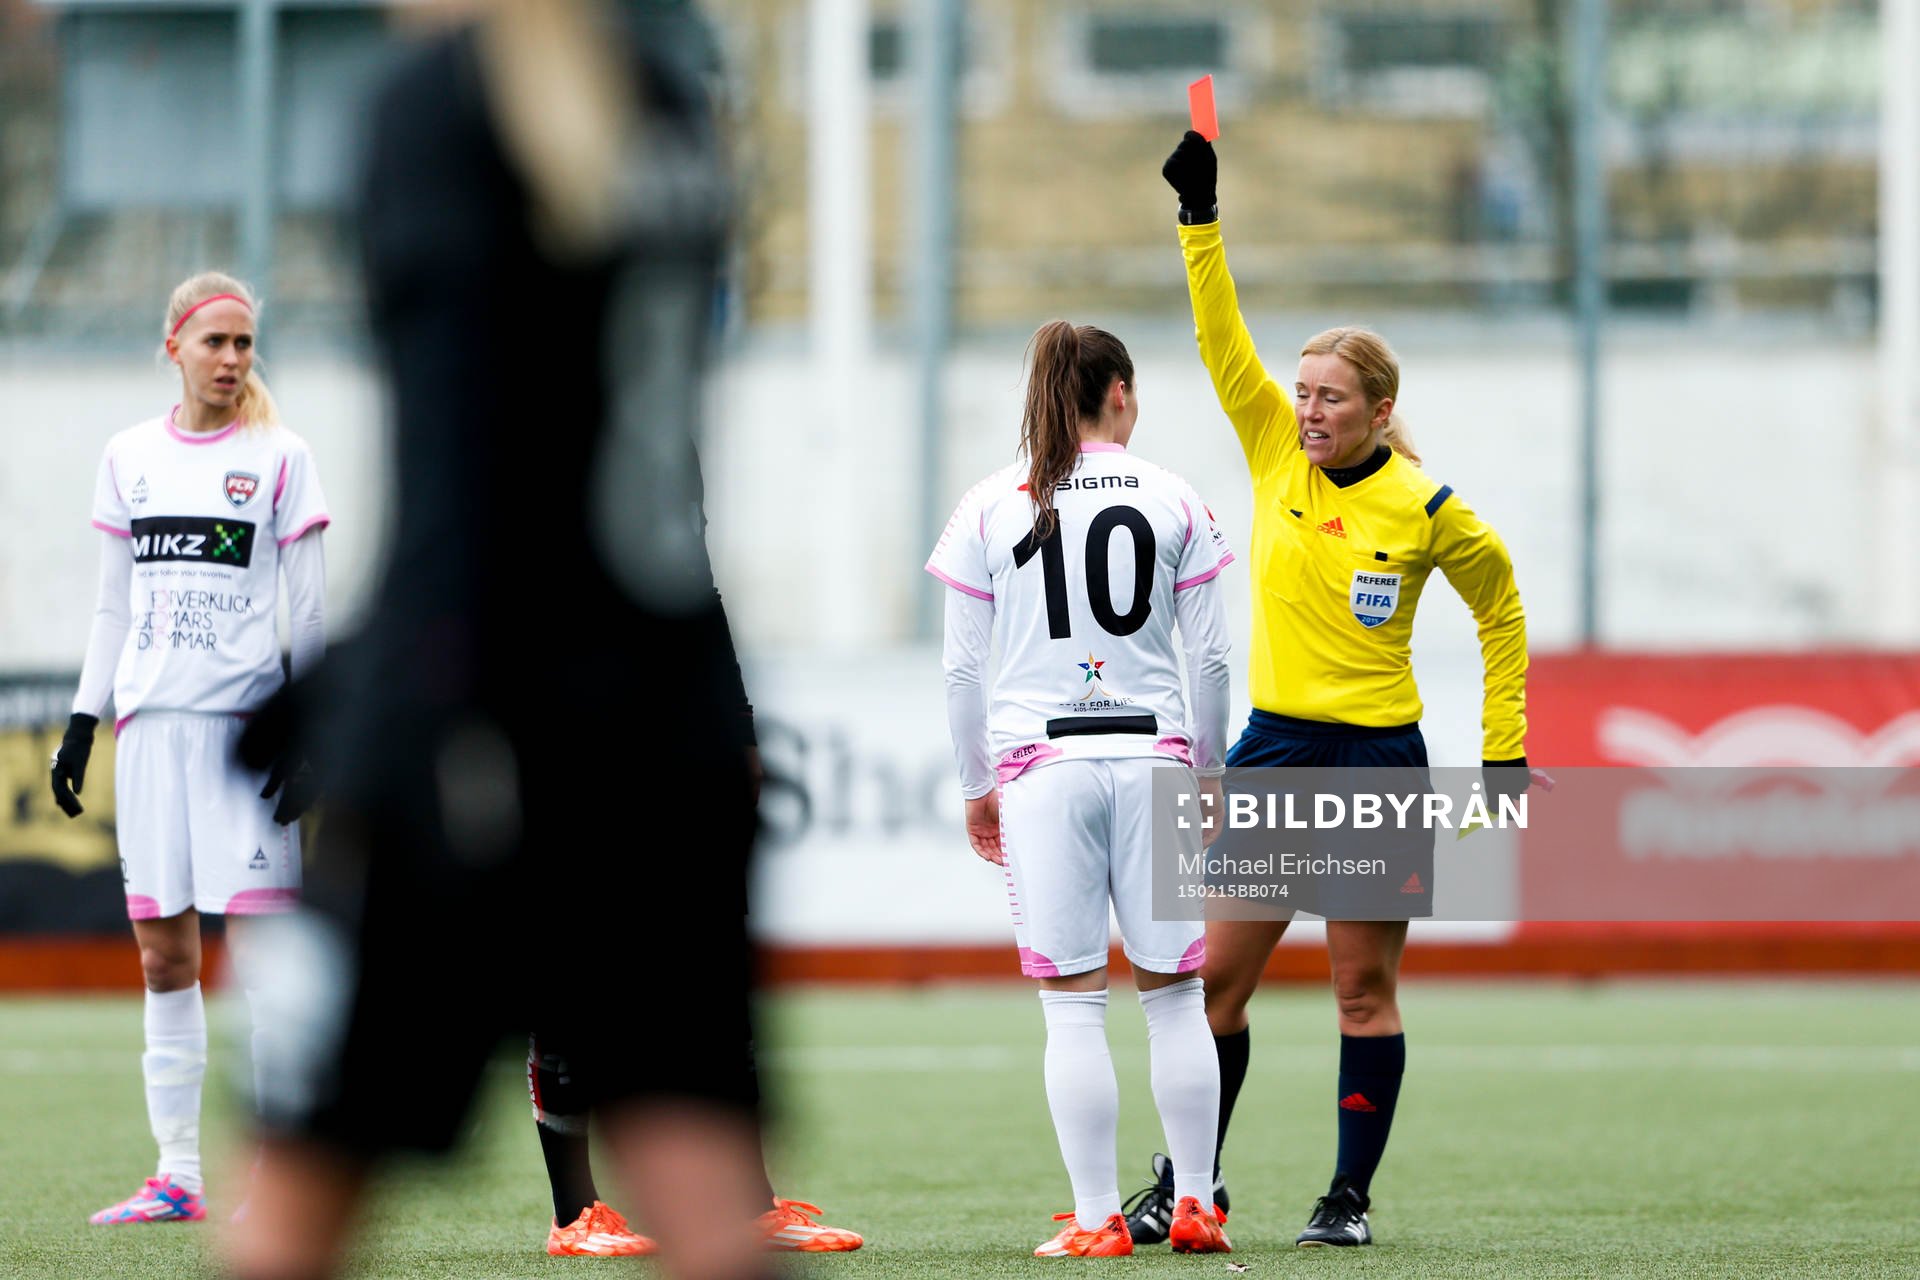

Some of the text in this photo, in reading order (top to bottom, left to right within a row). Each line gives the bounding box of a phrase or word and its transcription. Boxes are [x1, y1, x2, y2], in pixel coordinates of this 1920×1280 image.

[131, 533, 207, 558] MIKZ
[1012, 504, 1157, 640] 10
[1356, 575, 1398, 586] REFEREE
[1355, 592, 1392, 608] FIFA
[1090, 699, 1111, 708] FOR
[1012, 743, 1038, 760] SELECT
